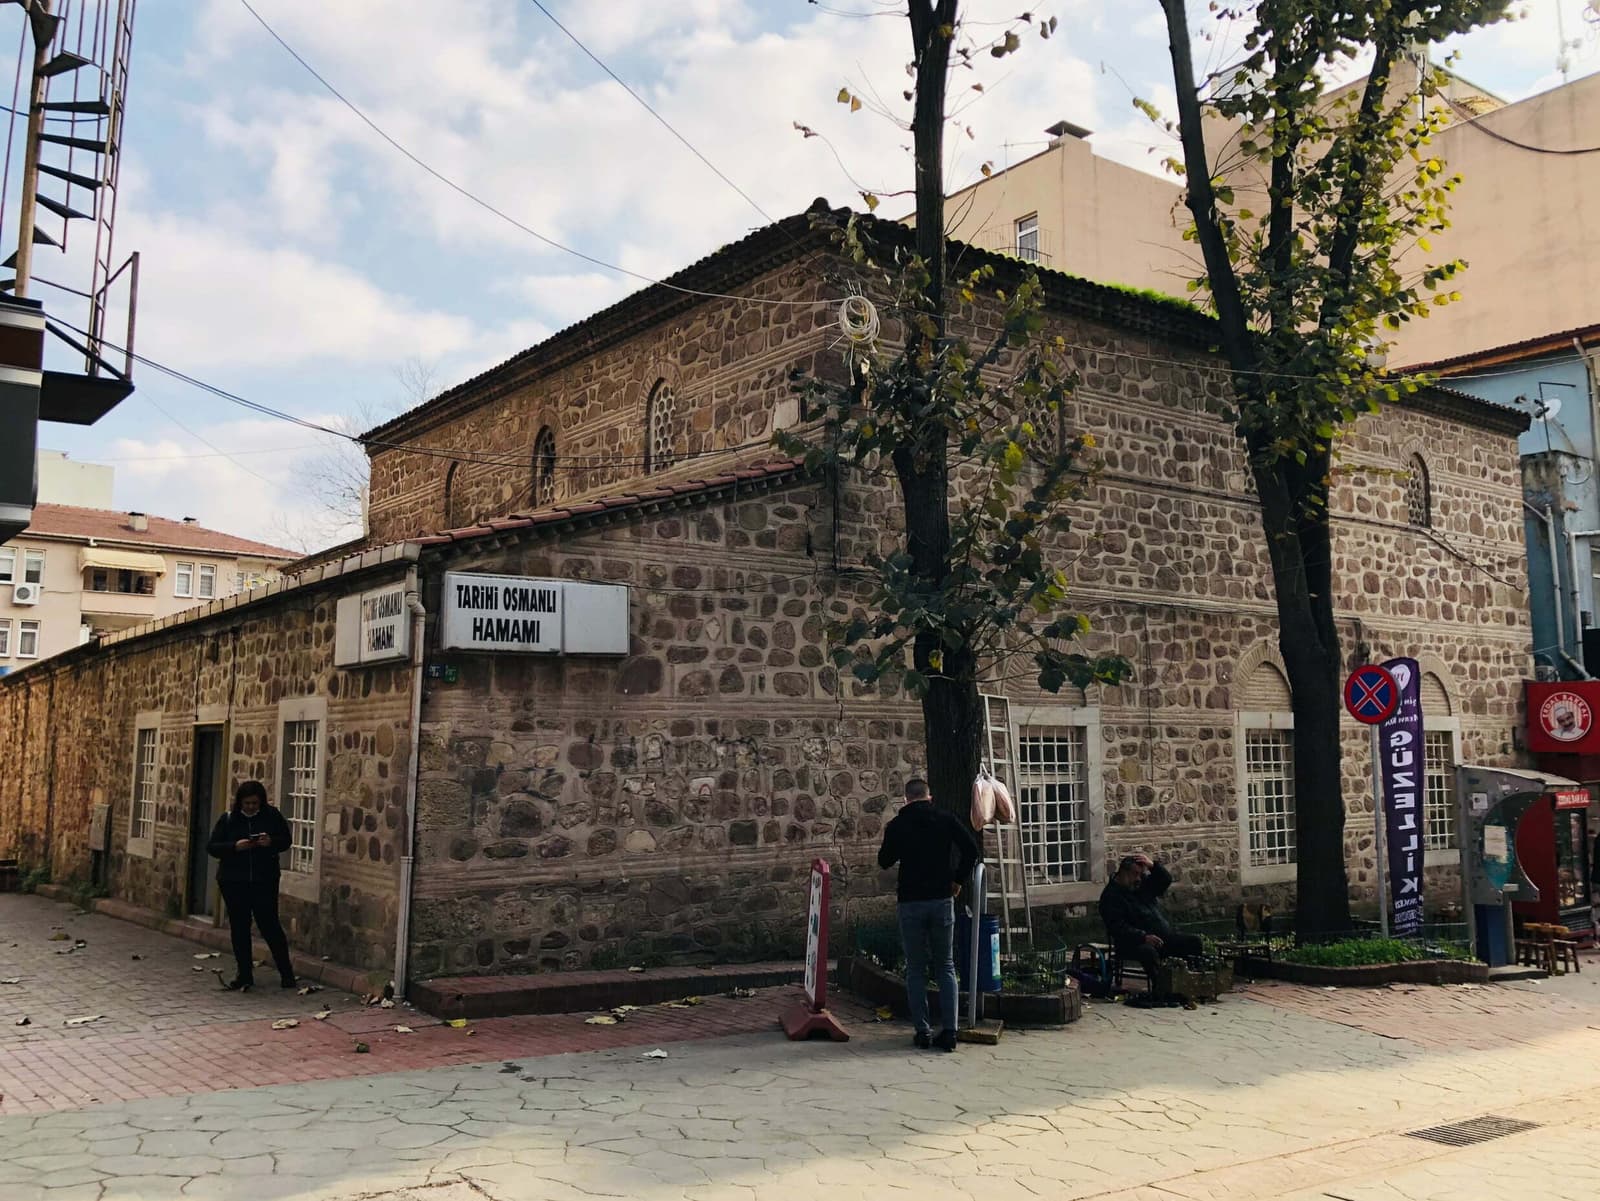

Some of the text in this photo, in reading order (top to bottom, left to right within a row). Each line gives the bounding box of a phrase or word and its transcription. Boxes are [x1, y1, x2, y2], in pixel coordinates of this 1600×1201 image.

[503, 586, 557, 613] OSMANLI
[367, 623, 395, 653] HAMAMI
[472, 617, 540, 643] HAMAMI
